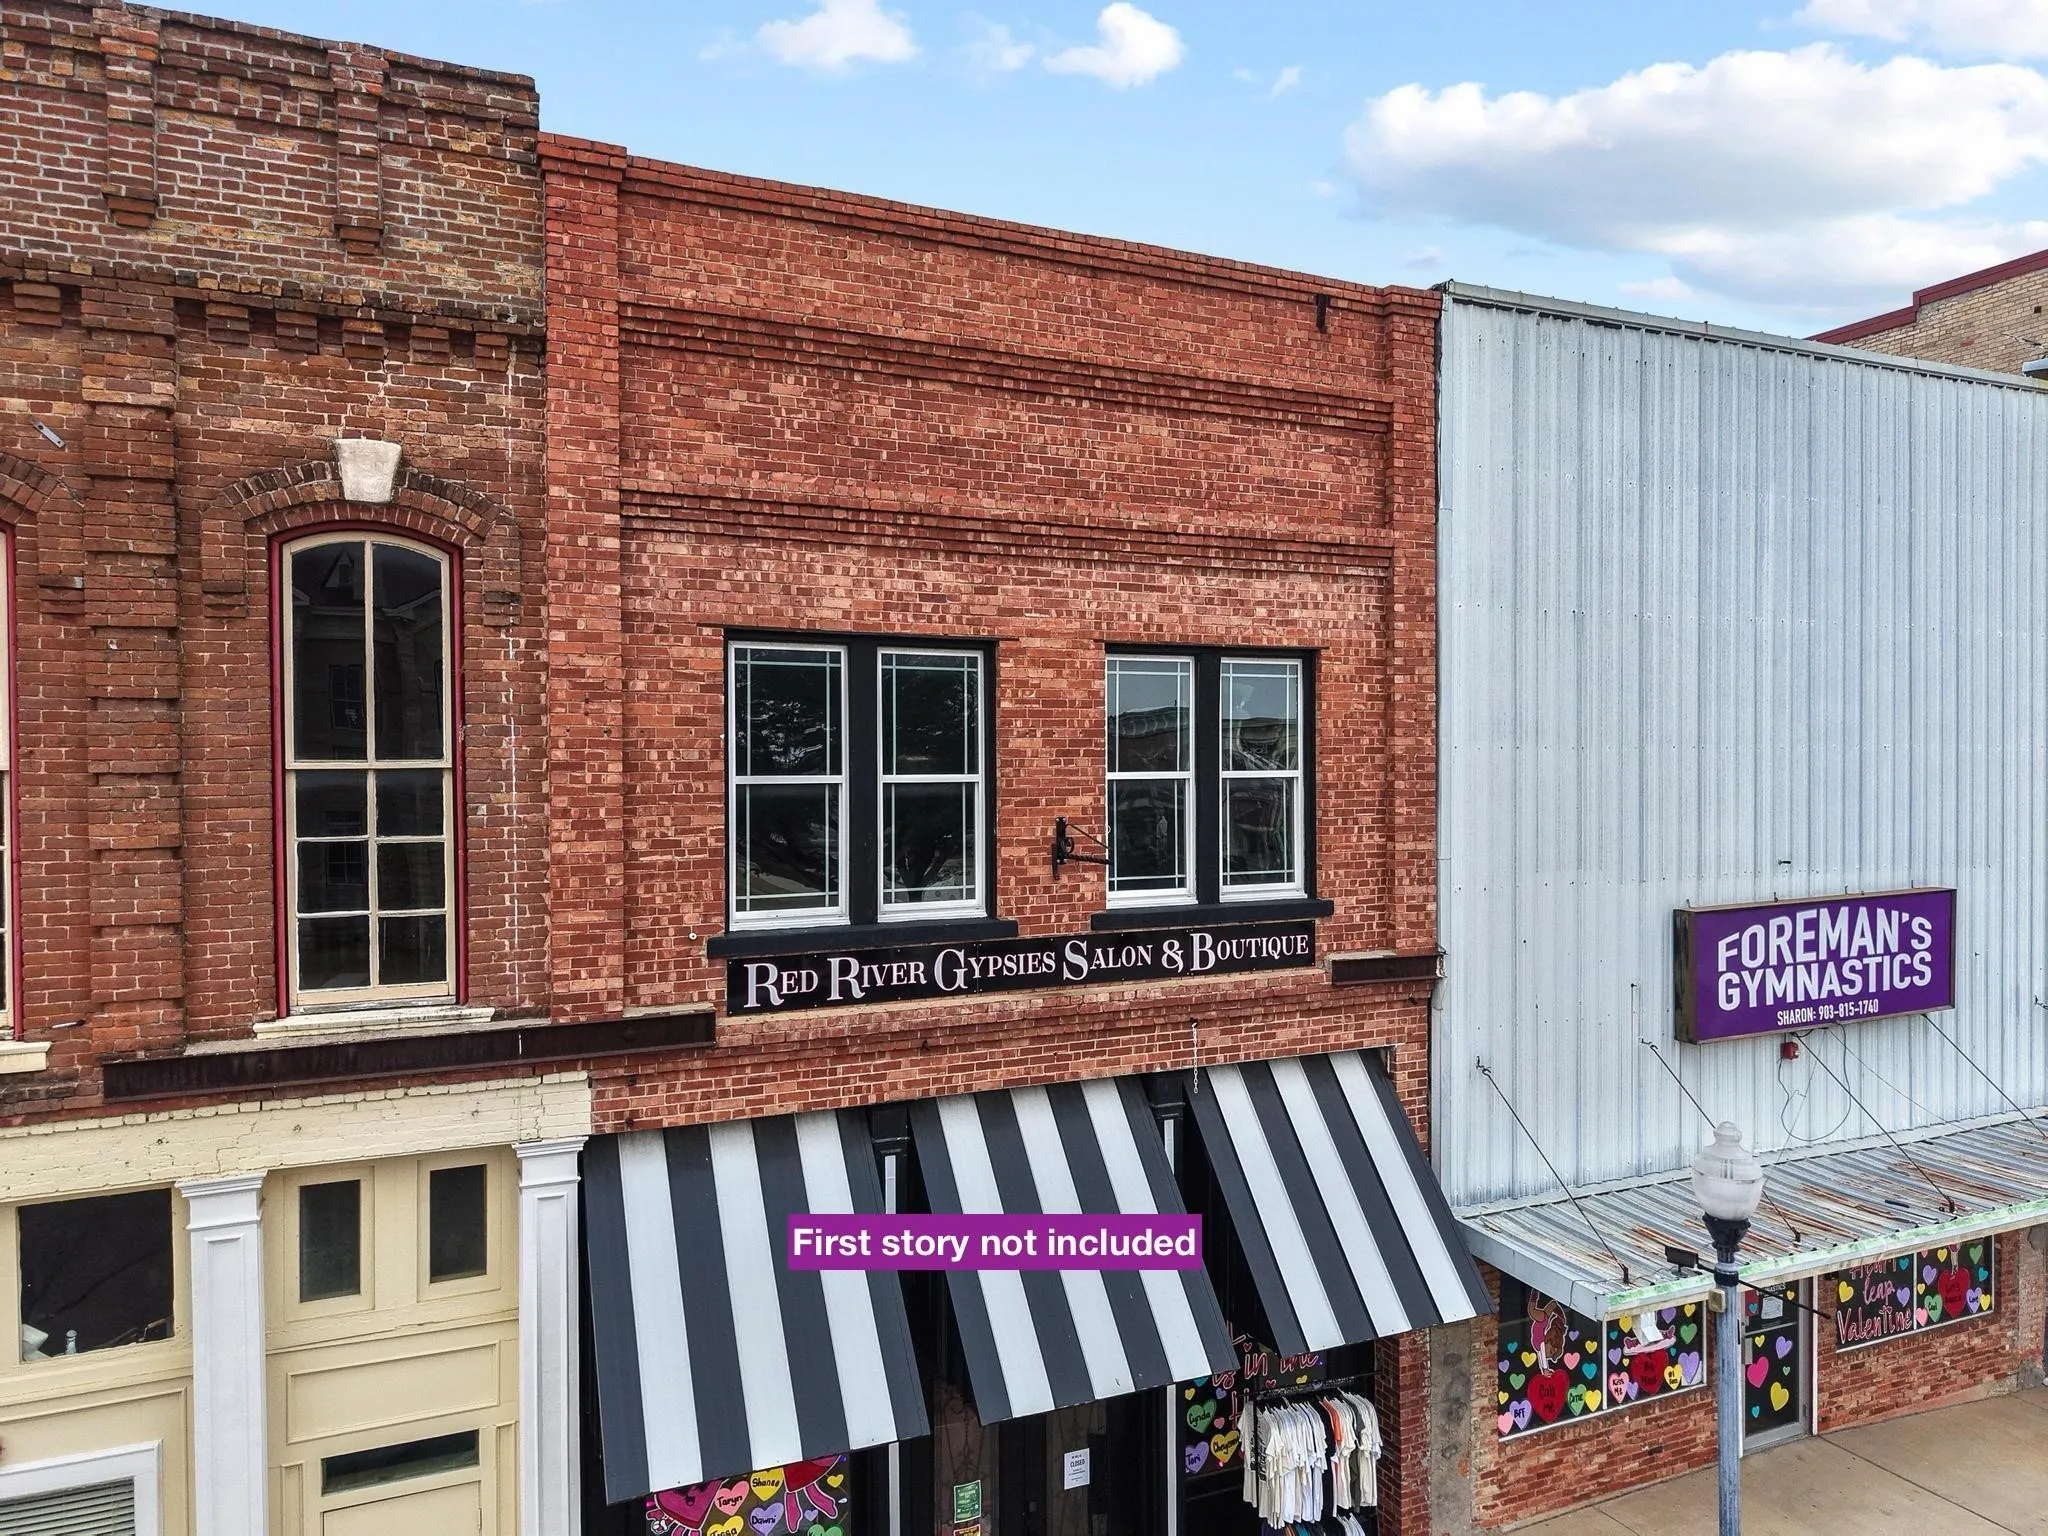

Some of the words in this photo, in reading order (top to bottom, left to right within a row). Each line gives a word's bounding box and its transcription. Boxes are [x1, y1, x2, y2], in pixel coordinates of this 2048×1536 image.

[1717, 905, 1933, 972] FOREMAN'S
[743, 962, 819, 1008] RED
[826, 956, 928, 1001] RIVER
[933, 948, 1056, 992] GYPSIES
[1063, 939, 1153, 981] SALON
[1162, 939, 1184, 973] &
[1189, 932, 1309, 972] BOUTIQUE
[1717, 949, 1933, 1012] GYMNASTICS
[1777, 1005, 1817, 1026] SHARON:
[1818, 998, 1879, 1020] 903-815-1740
[1513, 1407, 1526, 1419] BFF
[716, 1494, 743, 1508] Taryn
